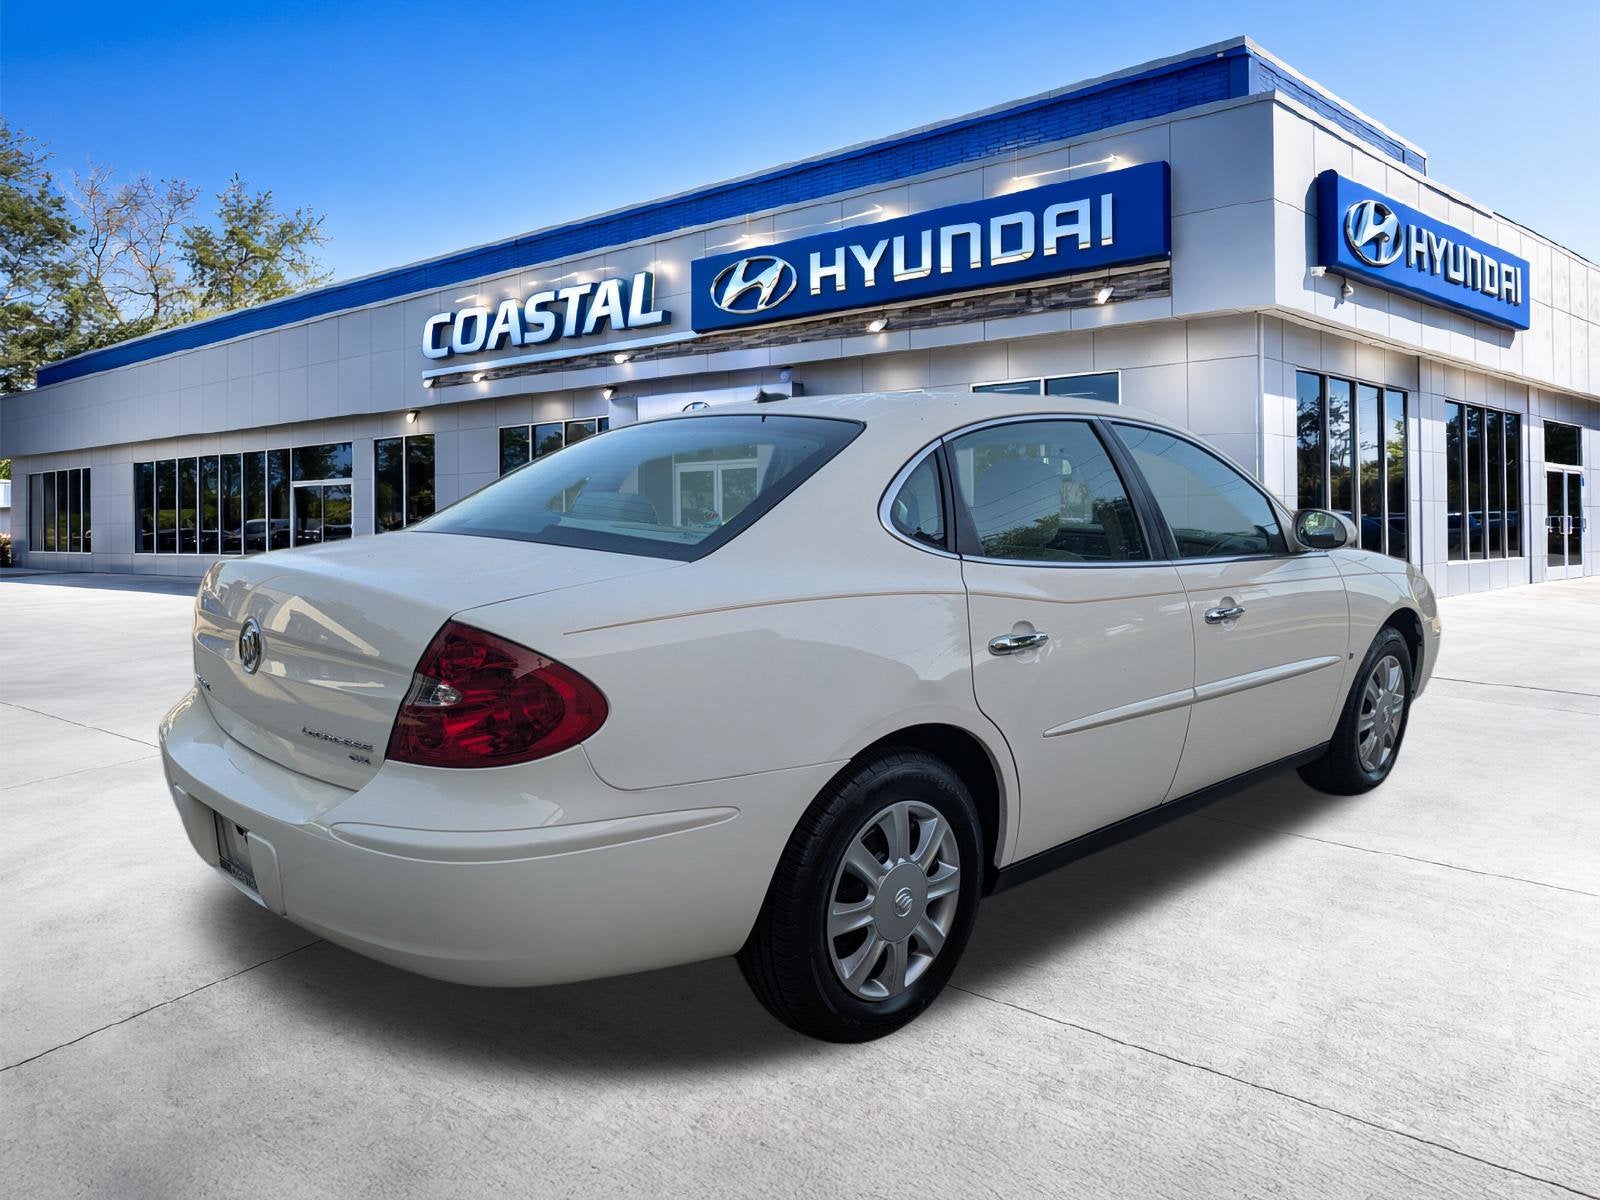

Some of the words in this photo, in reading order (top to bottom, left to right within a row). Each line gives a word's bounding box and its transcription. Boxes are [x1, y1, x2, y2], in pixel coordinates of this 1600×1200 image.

[809, 192, 1114, 296] HYUNDAI
[1406, 223, 1522, 307] HYUNDAI
[422, 271, 670, 359] COASTAL
